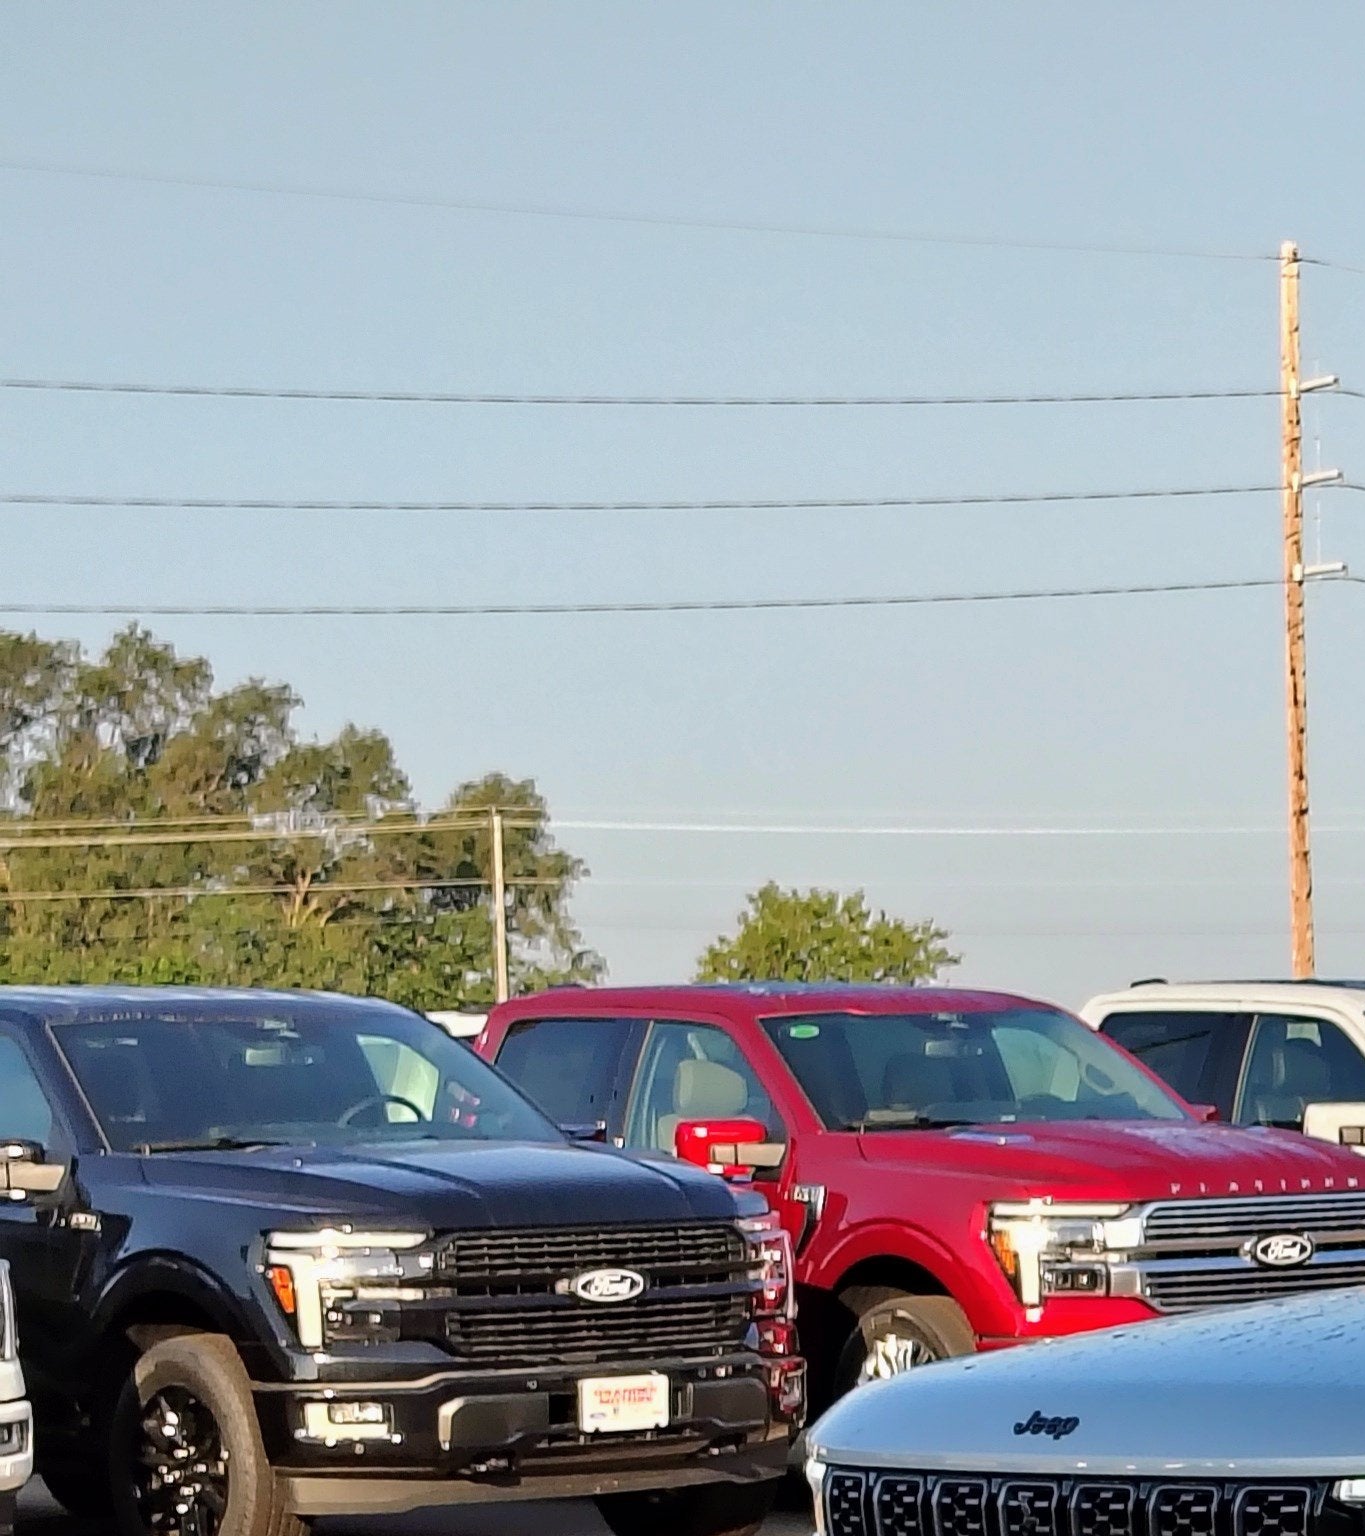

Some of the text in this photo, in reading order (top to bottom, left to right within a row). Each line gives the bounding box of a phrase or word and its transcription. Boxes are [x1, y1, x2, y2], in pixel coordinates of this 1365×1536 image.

[1264, 1238, 1304, 1262] Ford
[584, 1271, 637, 1298] Ford
[1013, 1410, 1080, 1440] Jeep
